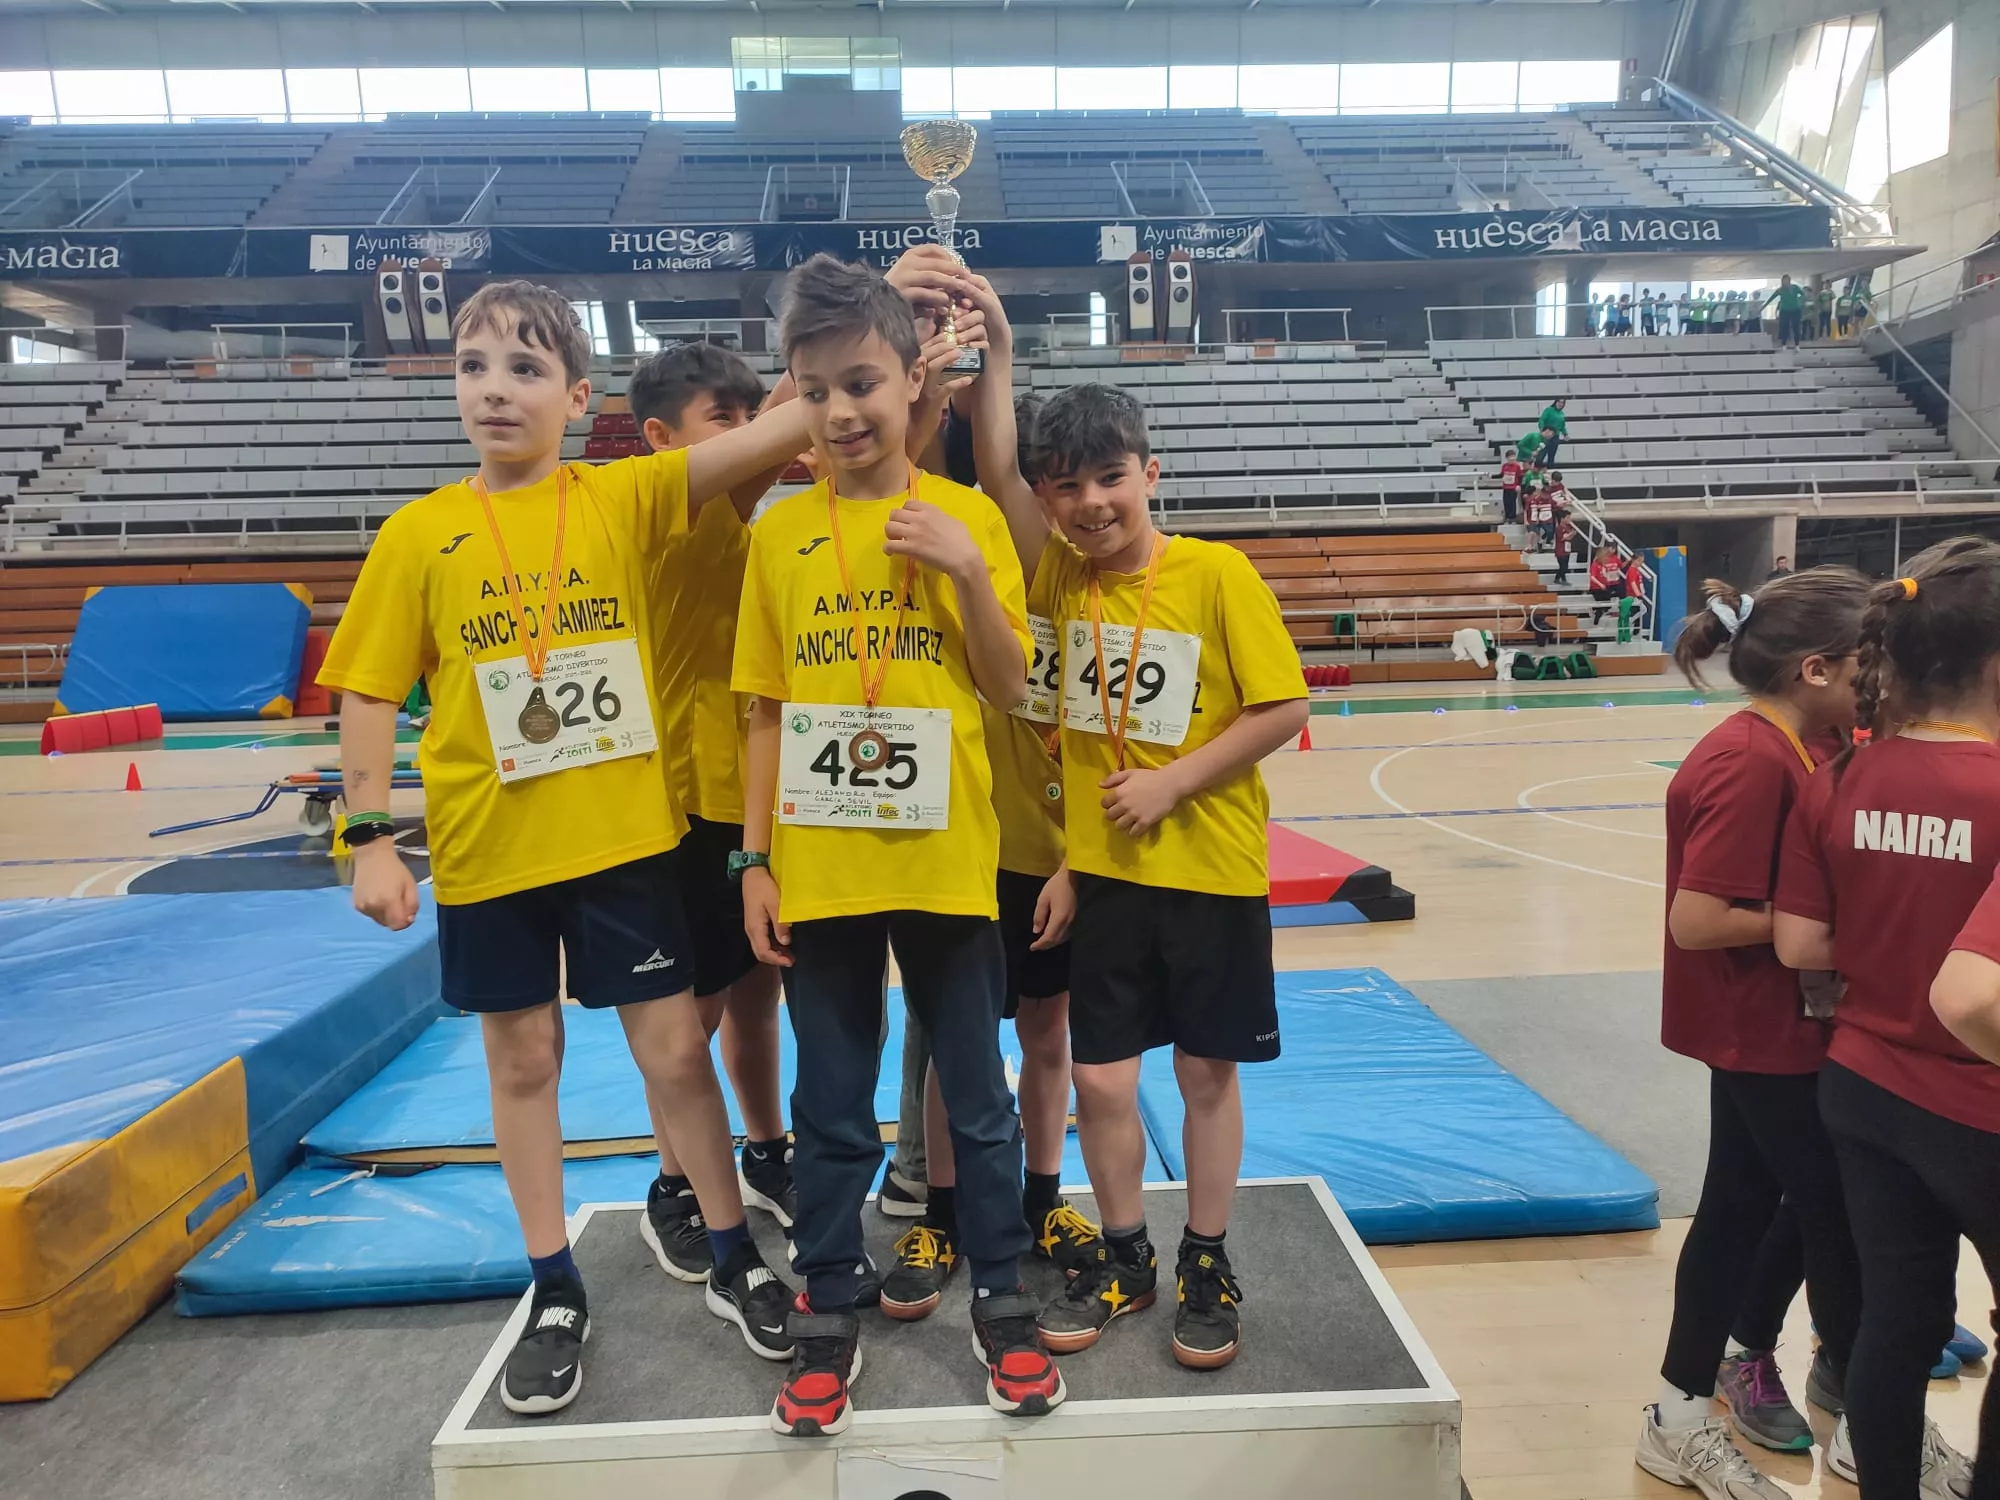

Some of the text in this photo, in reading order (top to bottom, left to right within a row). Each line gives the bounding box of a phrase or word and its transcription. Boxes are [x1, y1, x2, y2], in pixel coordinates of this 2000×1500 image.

[1144, 224, 1263, 244] Ayuntamiento
[355, 255, 376, 271] de
[566, 657, 609, 670] DIVERTIDO
[1079, 656, 1166, 705] 429
[839, 710, 893, 720] XIX TORNEO
[817, 720, 915, 731] ATLETISMO DIVERTIDO
[1854, 809, 1972, 863] NAIRA
[632, 957, 676, 973] MERCURY
[746, 1266, 778, 1291] NIKE
[536, 1306, 577, 1329] NIKE
